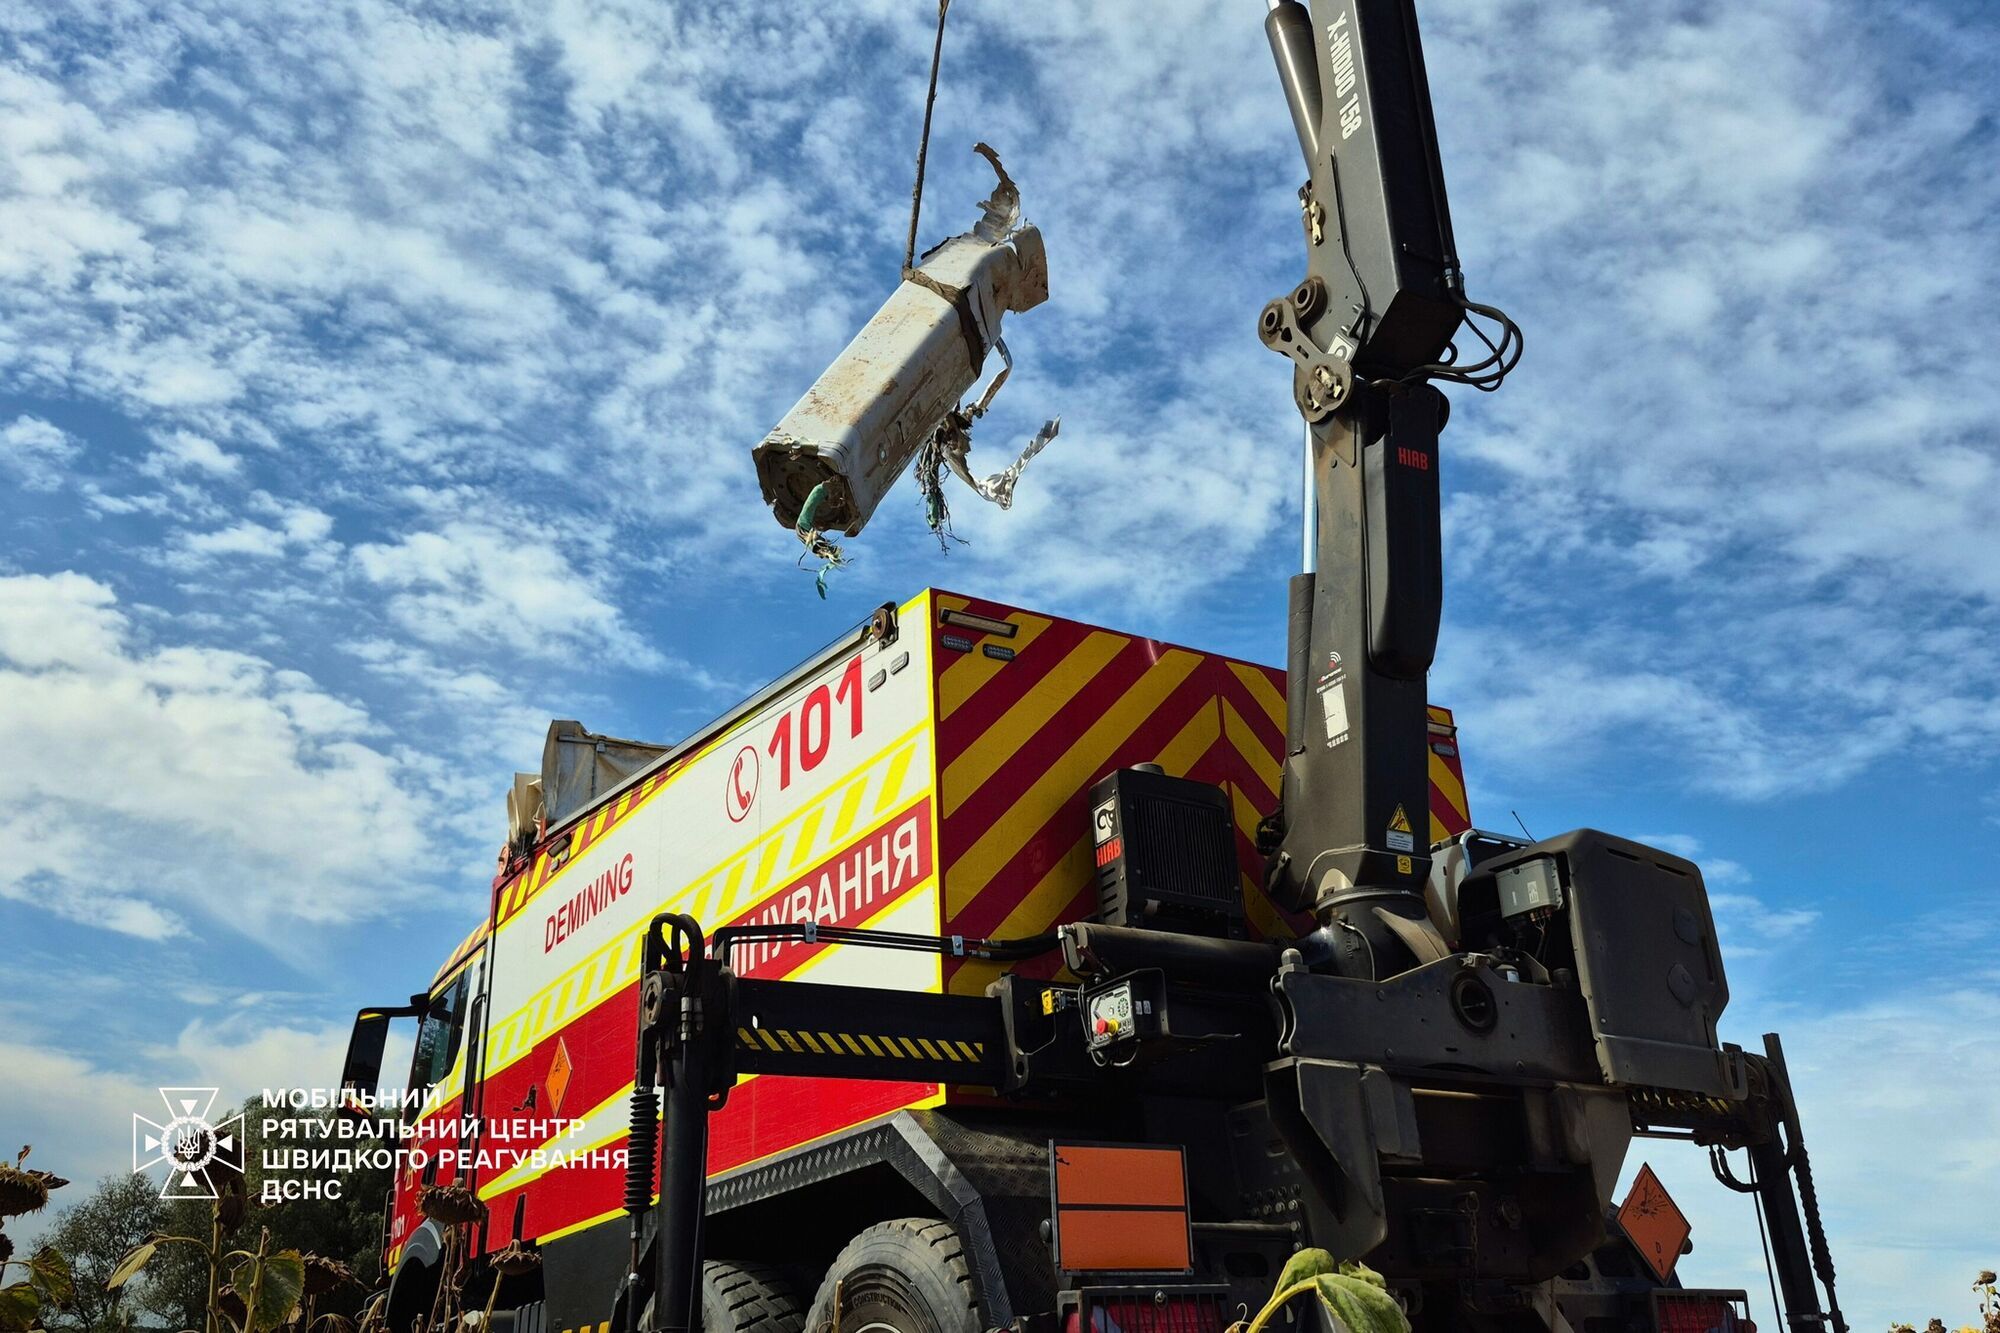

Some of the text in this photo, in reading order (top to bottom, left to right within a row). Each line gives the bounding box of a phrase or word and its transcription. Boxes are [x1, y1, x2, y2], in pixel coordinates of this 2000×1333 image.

[1327, 10, 1362, 140] X-HIDUO 158
[1398, 447, 1429, 471] HIAB
[768, 654, 863, 791] 101
[545, 853, 633, 954] DEMINING
[1096, 838, 1121, 868] HIAB
